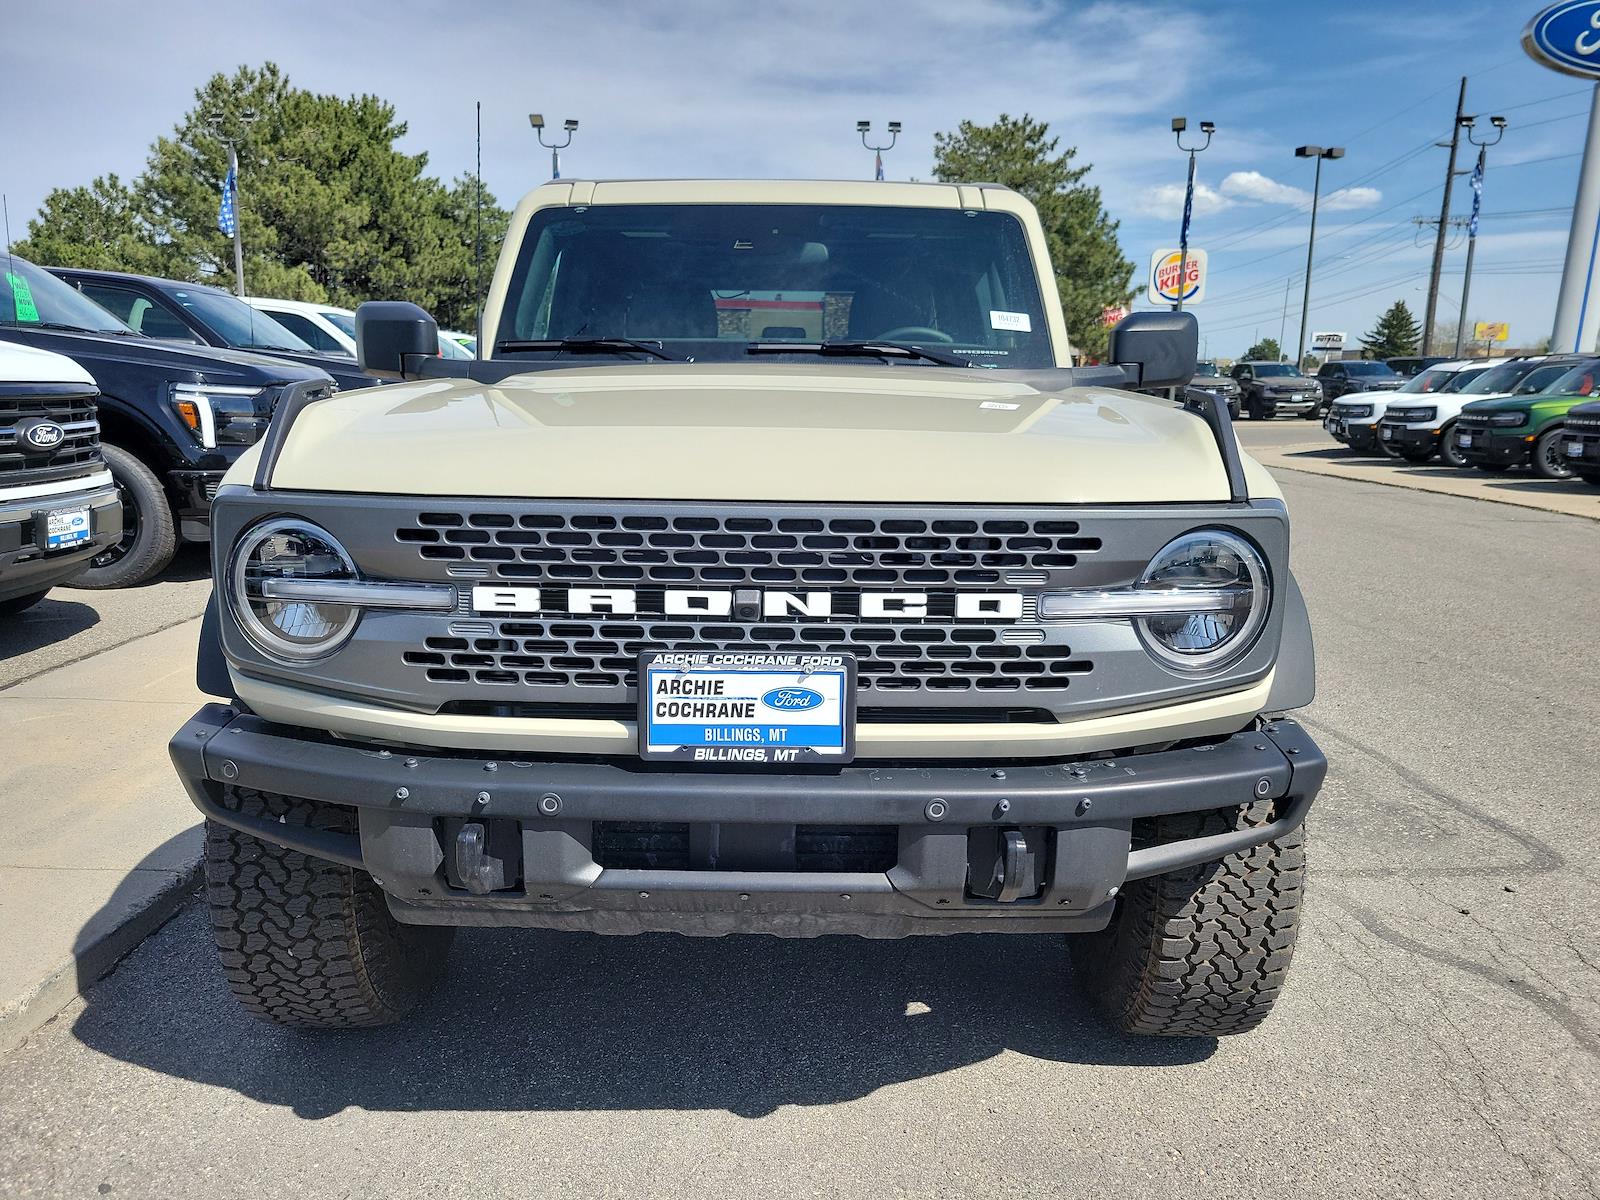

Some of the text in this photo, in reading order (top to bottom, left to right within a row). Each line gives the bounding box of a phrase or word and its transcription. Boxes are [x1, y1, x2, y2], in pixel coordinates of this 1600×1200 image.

[35, 427, 58, 443] Ford
[472, 586, 1024, 619] BRONCO
[652, 654, 843, 667] ARCHIE COCHRANE FORD
[656, 679, 725, 696] ARCHIE
[774, 690, 811, 708] Ford
[656, 701, 756, 719] COCHRANE
[704, 727, 788, 744] BILLINGS, MT
[693, 748, 800, 763] BILLINGS, MT
